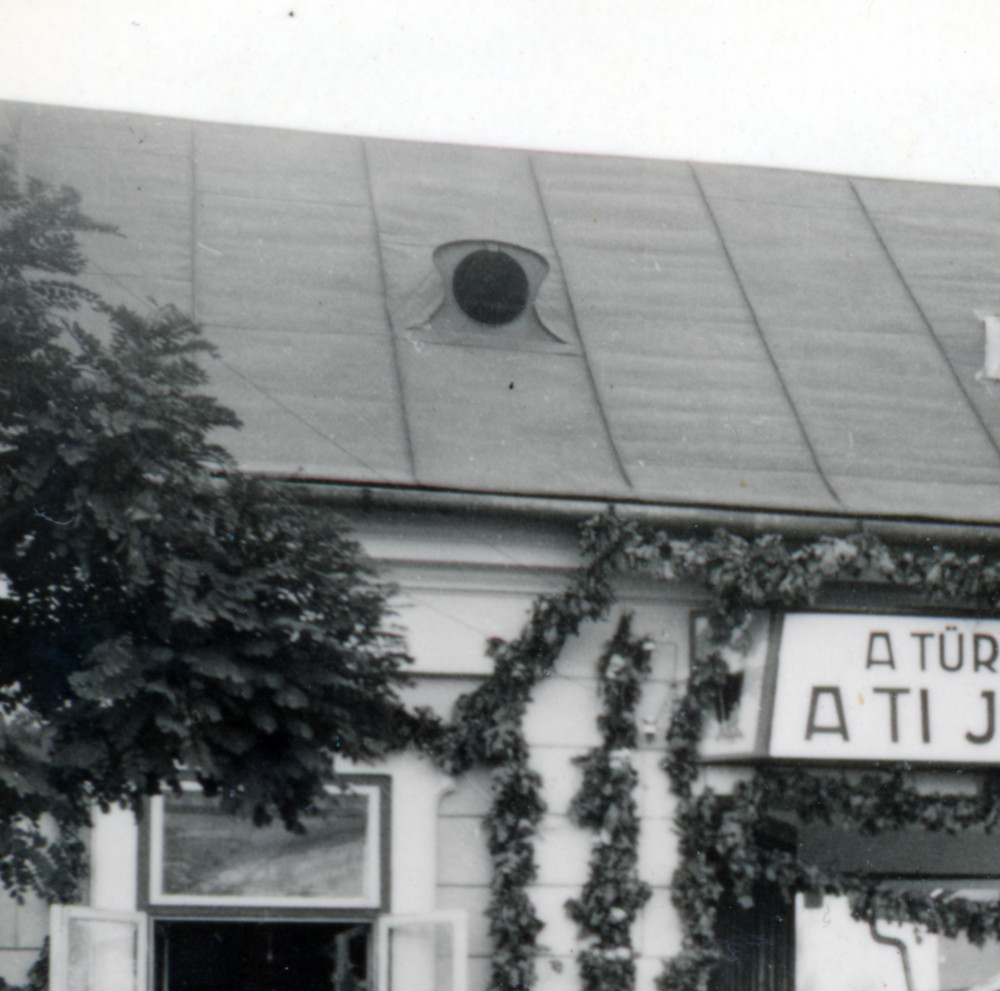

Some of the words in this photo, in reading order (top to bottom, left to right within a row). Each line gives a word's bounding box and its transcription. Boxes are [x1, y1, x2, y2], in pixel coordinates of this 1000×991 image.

[866, 631, 895, 670] A
[805, 686, 849, 742] A
[873, 687, 931, 744] TI
